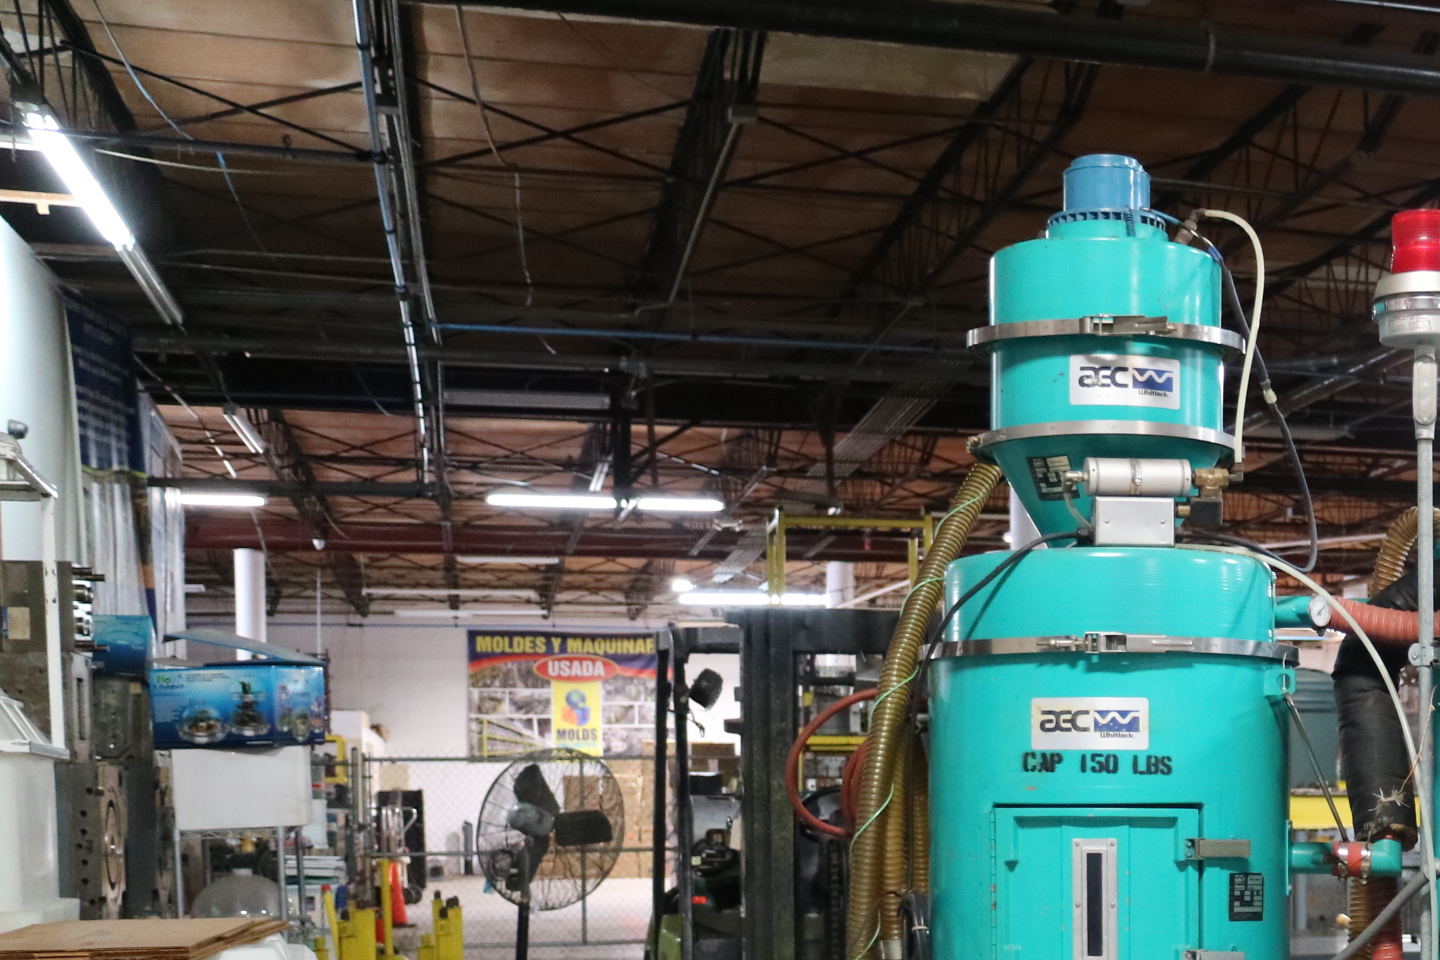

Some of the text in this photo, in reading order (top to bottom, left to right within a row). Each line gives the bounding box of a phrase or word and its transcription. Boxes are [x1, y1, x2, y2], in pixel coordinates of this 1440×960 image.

[1138, 389, 1168, 397] Whitlock
[476, 636, 547, 653] MOLDES
[551, 637, 561, 653] Y
[548, 660, 606, 677] USADA
[557, 729, 597, 741] MOLDS
[1022, 752, 1173, 775] CAP 150 LBS
